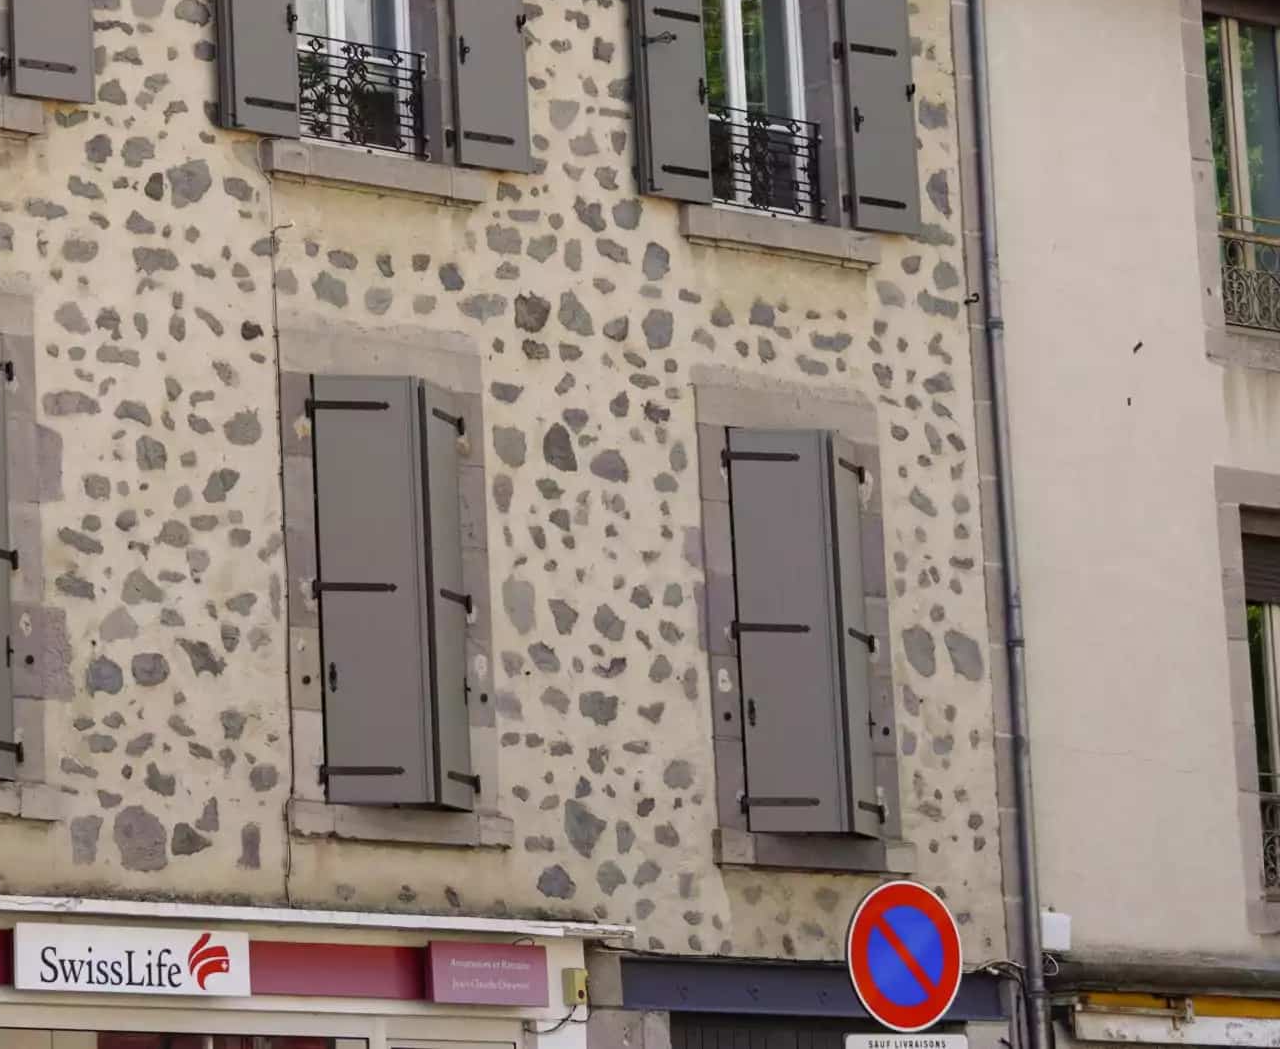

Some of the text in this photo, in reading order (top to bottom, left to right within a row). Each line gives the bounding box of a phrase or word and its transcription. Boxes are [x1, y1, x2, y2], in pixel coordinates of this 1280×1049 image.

[39, 946, 183, 988] SwissLife
[868, 1039, 946, 1049] SAUF LIVRAISONS
